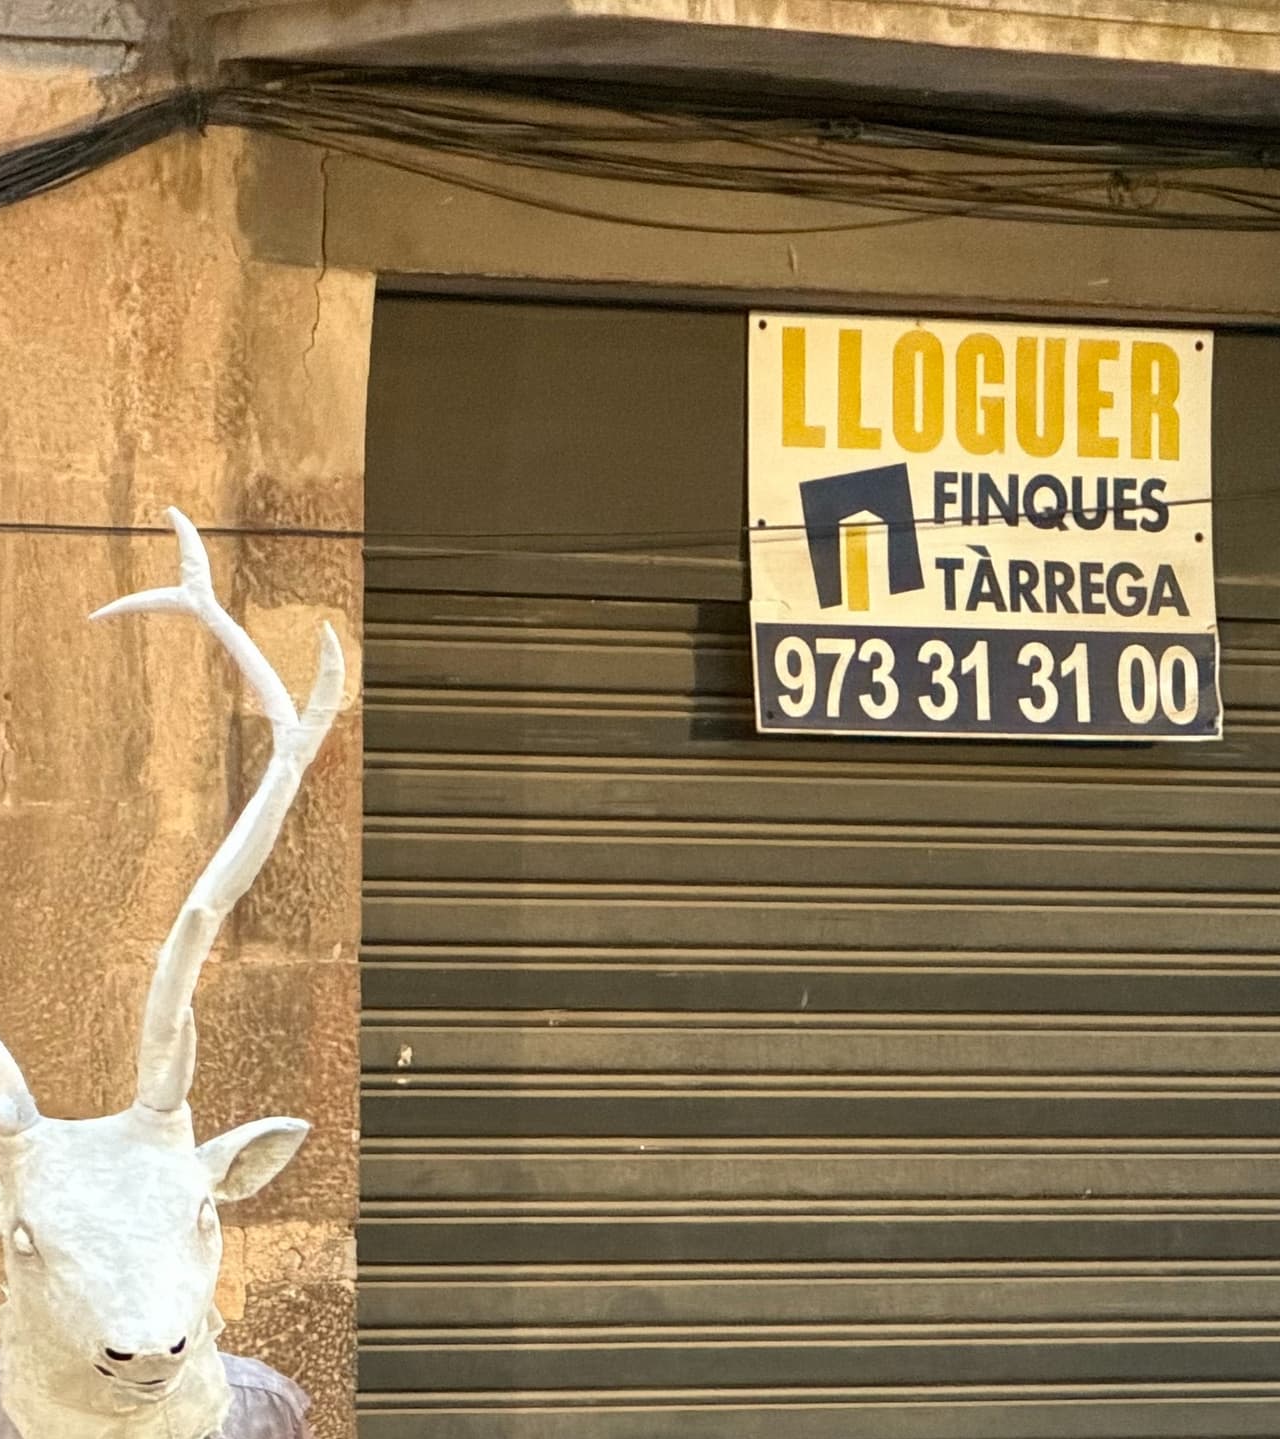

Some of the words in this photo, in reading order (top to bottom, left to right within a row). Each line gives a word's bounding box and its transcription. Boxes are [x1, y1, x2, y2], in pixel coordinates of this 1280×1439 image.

[782, 326, 1180, 461] LLOGUER
[933, 471, 1169, 532] FINQUES
[935, 544, 1190, 617] TÀRREGA
[774, 636, 900, 720] 973
[918, 639, 991, 723] 31
[1018, 642, 1091, 724] 31
[1119, 644, 1199, 725] 00
